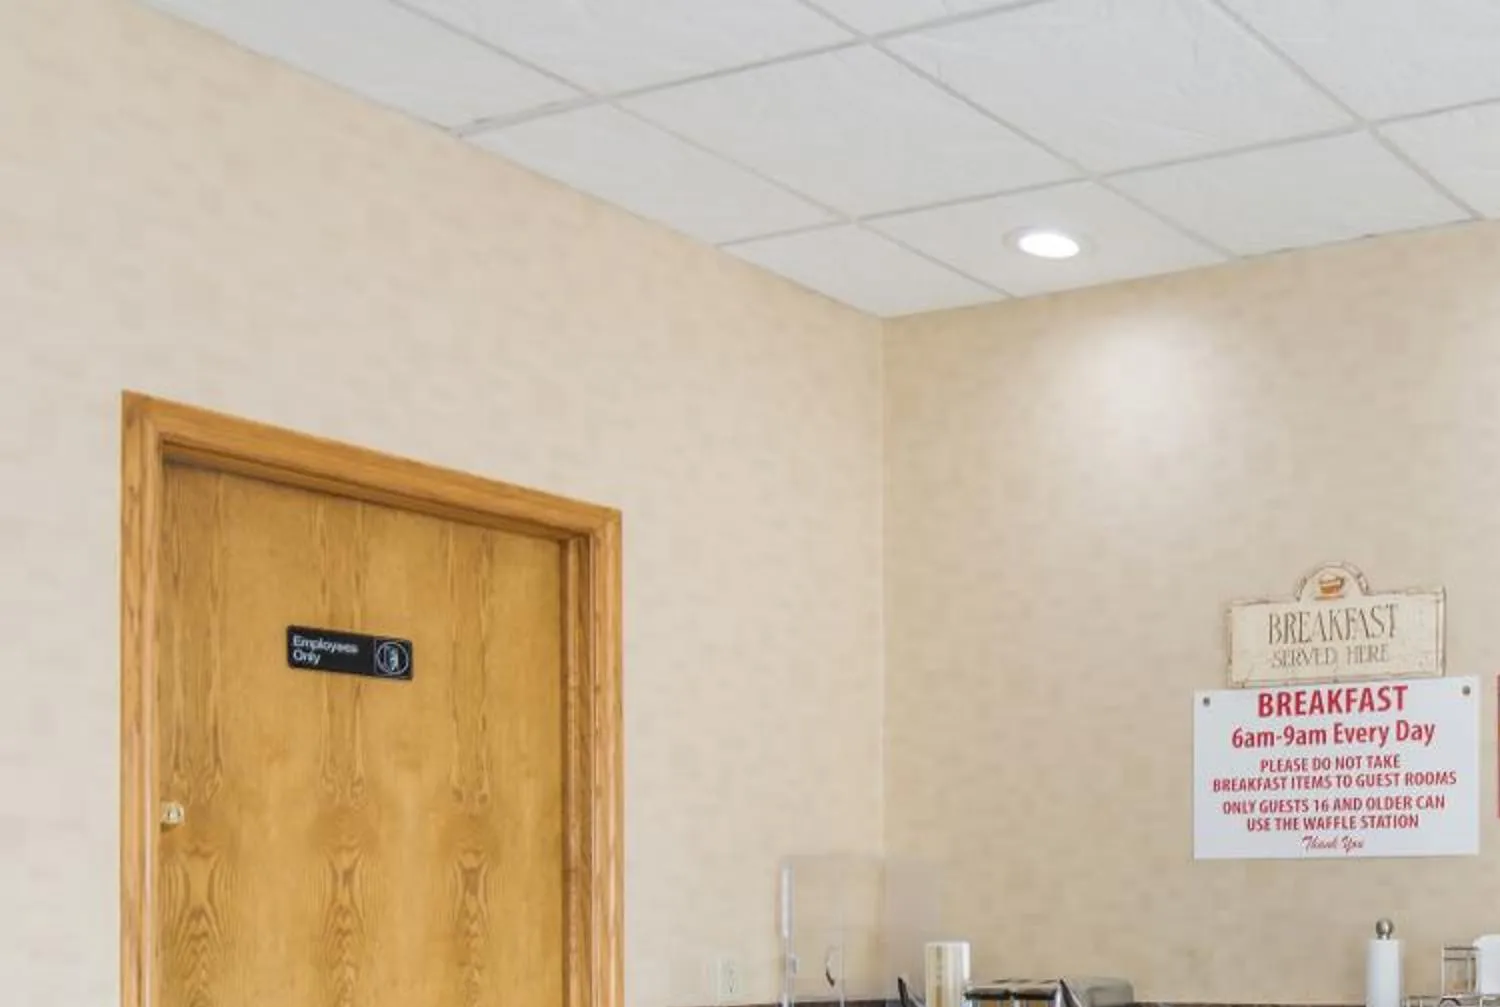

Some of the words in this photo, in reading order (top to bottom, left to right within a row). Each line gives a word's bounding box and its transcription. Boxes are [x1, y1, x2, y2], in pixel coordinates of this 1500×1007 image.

[1268, 604, 1398, 645] BREAKFAST
[293, 635, 359, 654] Employees
[293, 649, 321, 666] Only
[1271, 648, 1338, 669] SERVED
[1347, 645, 1390, 665] HERE
[1257, 685, 1408, 718] BREAKFAST
[1231, 724, 1328, 749] 6am-9am
[1333, 719, 1390, 748] Every
[1395, 719, 1436, 749] Day
[1259, 758, 1309, 773] PLEASE
[1311, 756, 1331, 771] DO
[1335, 755, 1363, 770] NOT
[1366, 754, 1401, 769] TAKE
[1212, 777, 1288, 793] BREAKFAST
[1291, 775, 1333, 790] ITEMS
[1336, 774, 1353, 788] TO
[1355, 773, 1401, 787] GUEST
[1404, 771, 1457, 787] ROOMS
[1223, 800, 1256, 815] ONLY
[1259, 799, 1310, 813] GUESTS
[1313, 798, 1329, 812] 16
[1333, 797, 1363, 811] AND
[1365, 795, 1412, 811] OLDER
[1415, 794, 1446, 809] CAN
[1247, 817, 1271, 832] USE
[1275, 816, 1299, 831] THE
[1303, 815, 1357, 831] WAFFLE
[1360, 814, 1419, 829] STATION
[1301, 836, 1338, 853] Thank
[1341, 835, 1364, 853] You
